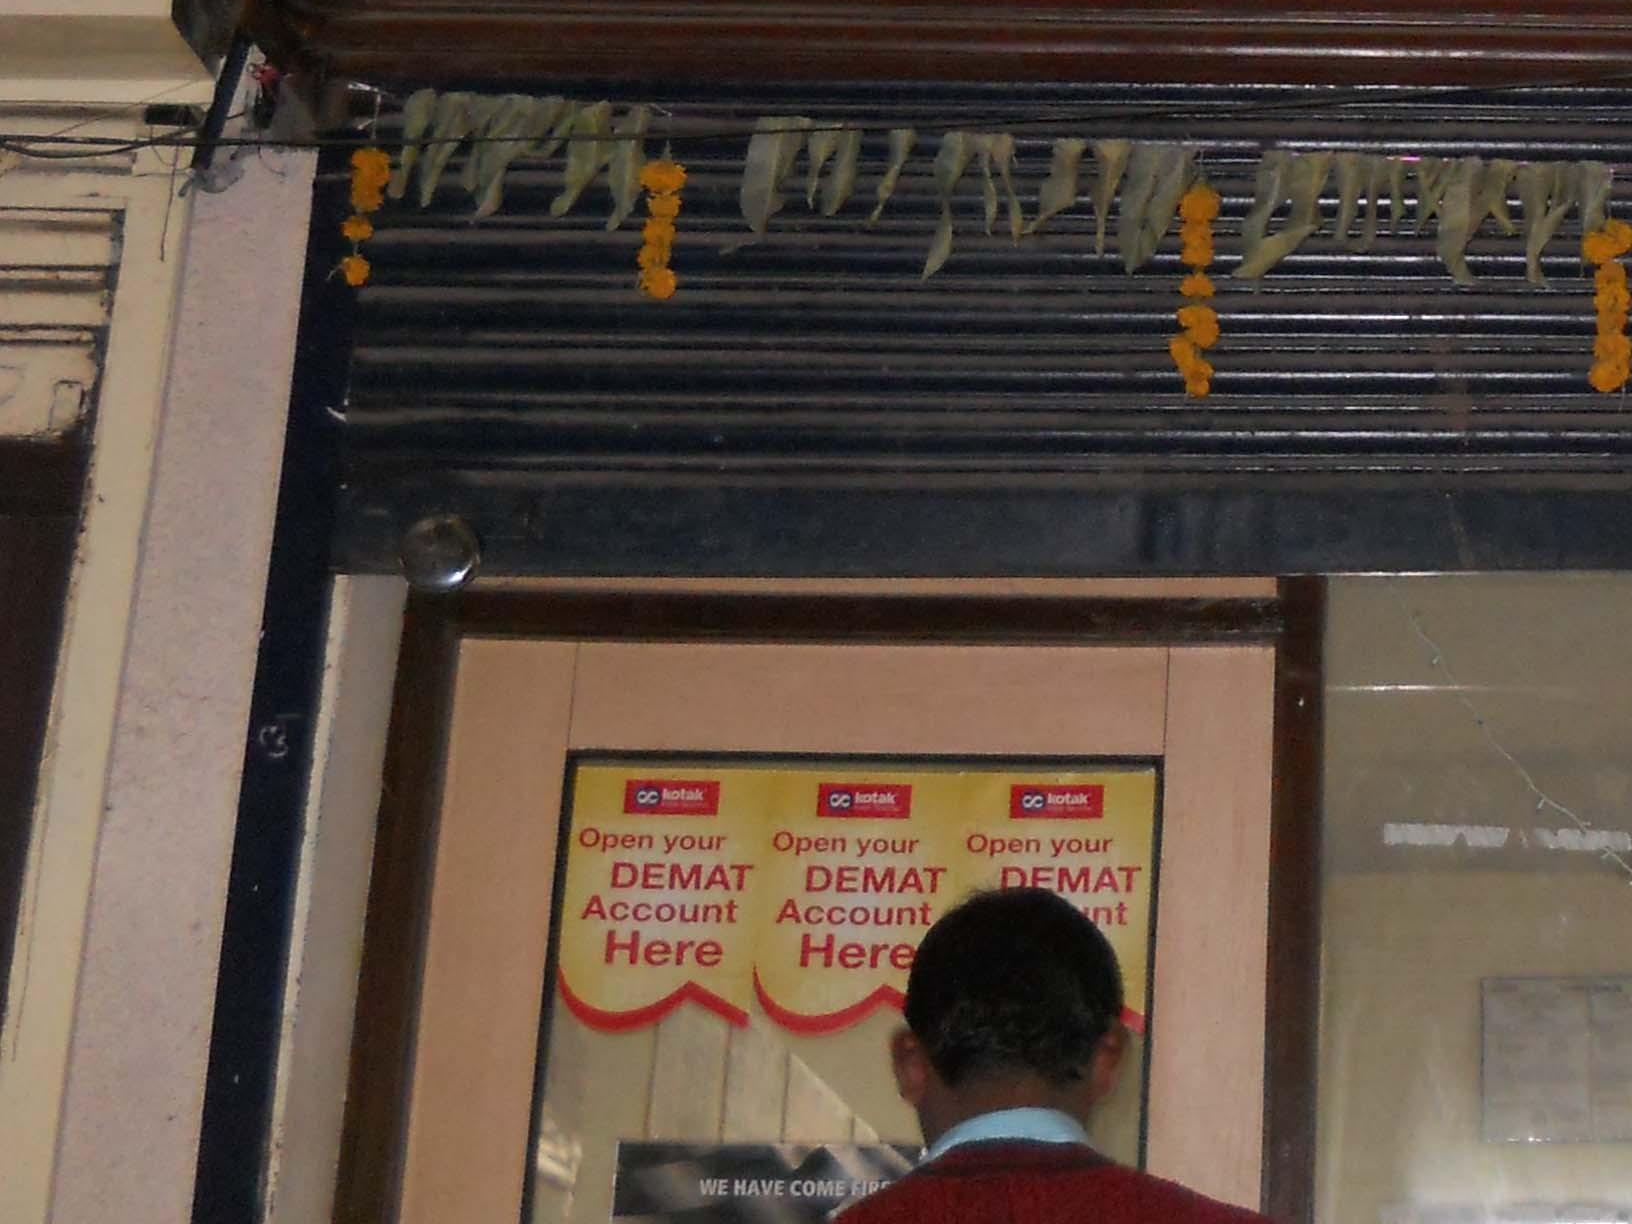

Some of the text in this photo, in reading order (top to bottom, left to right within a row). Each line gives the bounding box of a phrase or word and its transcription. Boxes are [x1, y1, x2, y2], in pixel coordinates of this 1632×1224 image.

[662, 788, 704, 801] kotak
[854, 792, 896, 804] kotak
[1047, 792, 1088, 805] kotak
[579, 828, 727, 854] Open your
[773, 831, 919, 857] Open your
[966, 834, 1113, 857] Open your
[611, 862, 754, 891] DEMAT
[805, 865, 947, 894] DEMAT
[581, 894, 738, 923] Account
[776, 898, 932, 926] Account
[604, 930, 723, 966] Here
[799, 934, 916, 969] Here
[700, 1179, 729, 1196] WE
[733, 1179, 784, 1196] HAVE
[789, 1180, 845, 1196] COME
